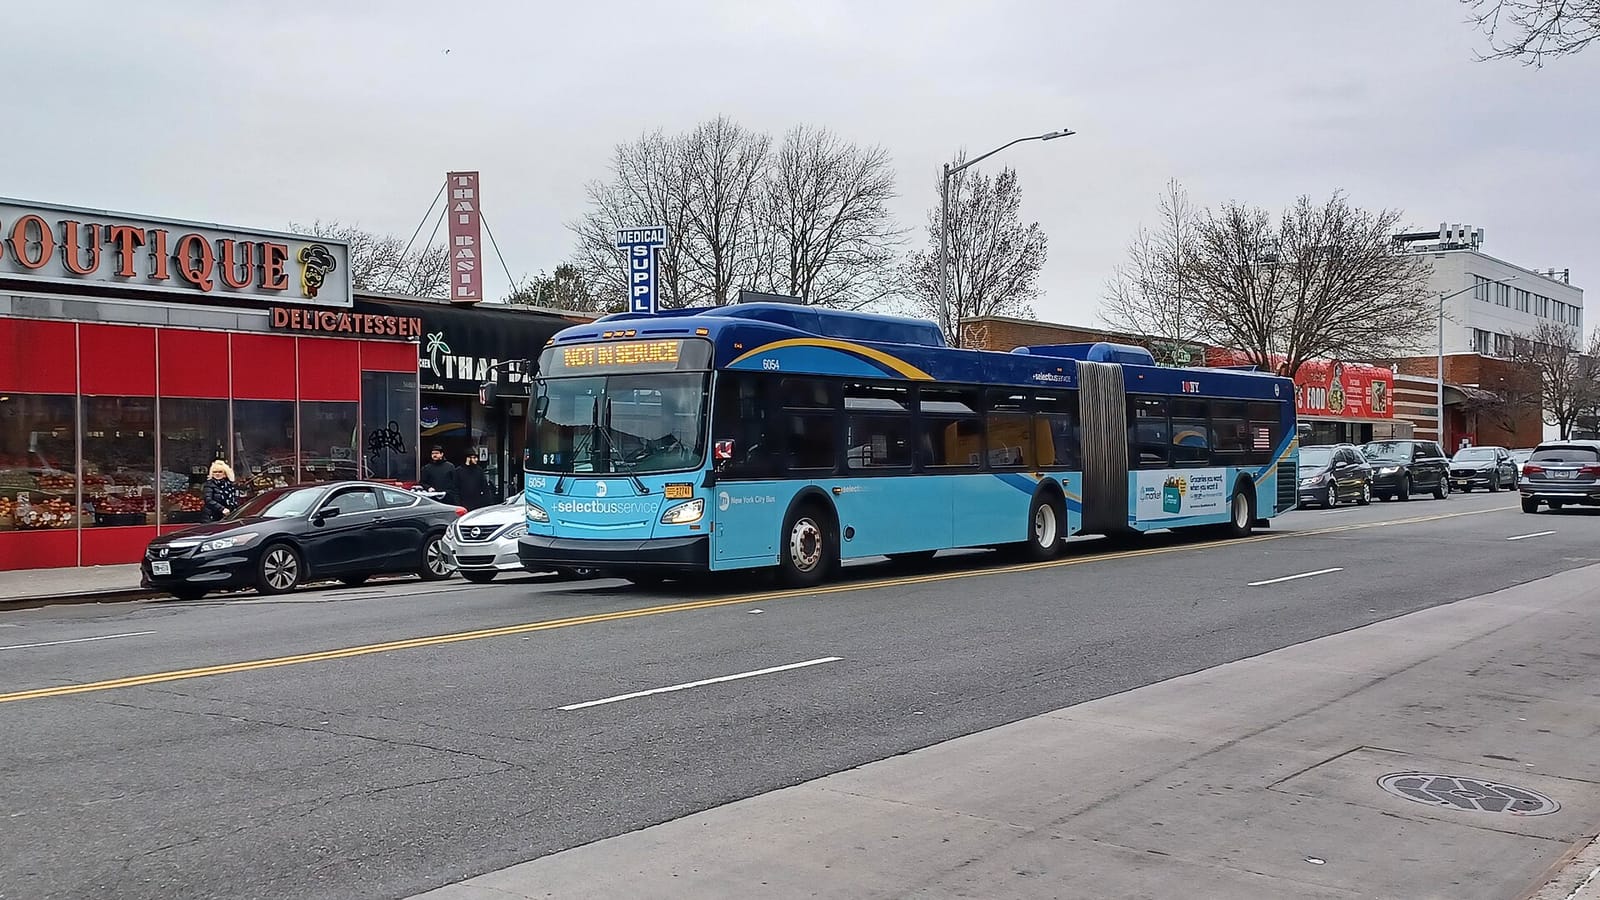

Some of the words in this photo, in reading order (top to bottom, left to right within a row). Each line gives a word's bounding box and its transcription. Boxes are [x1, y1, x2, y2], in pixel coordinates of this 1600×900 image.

[452, 175, 474, 225] THAI
[617, 230, 664, 244] MEDICAL
[0, 213, 290, 292] OUTIQUE
[455, 235, 476, 297] BASIL
[273, 307, 422, 336] DELICATESSEN
[564, 347, 595, 367] NOT
[597, 346, 614, 365] IN
[614, 341, 679, 364] SERVICE
[762, 358, 780, 370] 6054
[441, 355, 498, 382] THAI
[1307, 387, 1326, 409] FOOD
[527, 477, 547, 489] 6054
[743, 496, 754, 504] York
[755, 495, 766, 504] City
[766, 495, 776, 503] Bus
